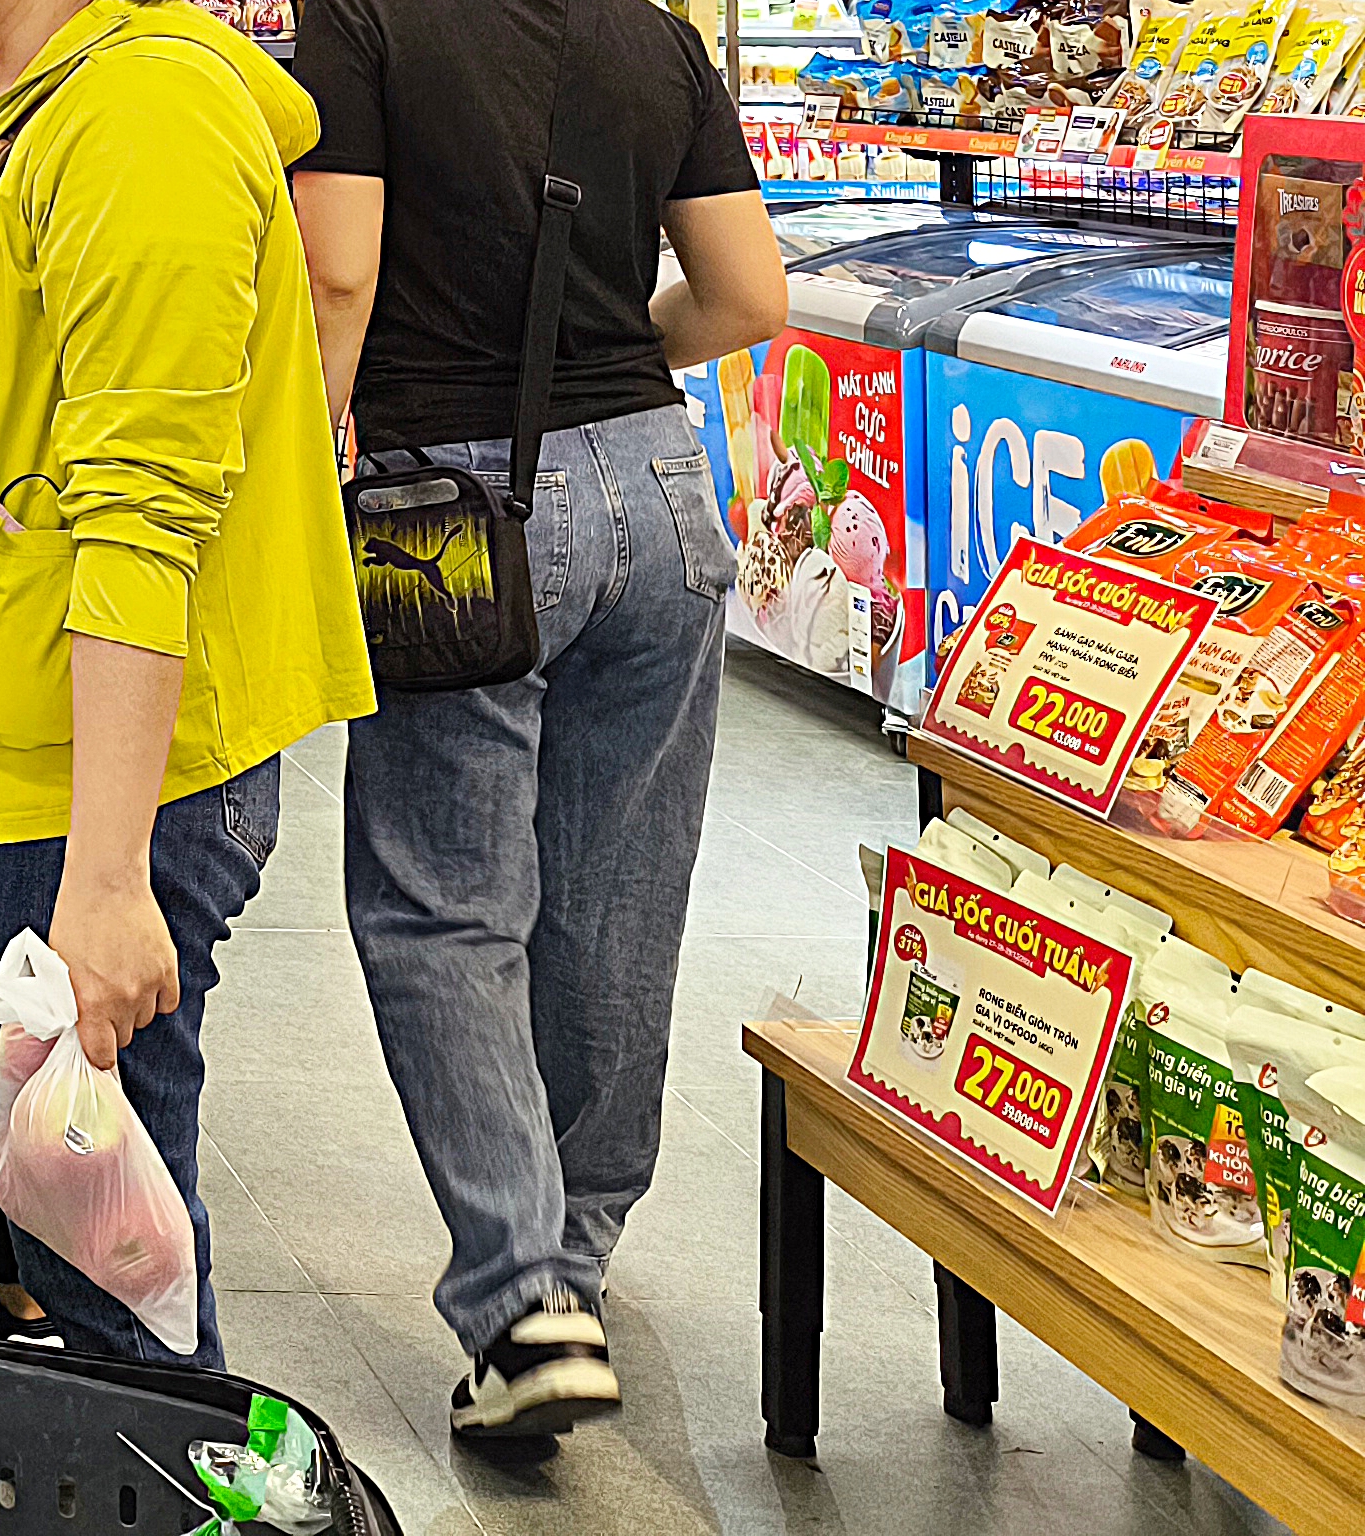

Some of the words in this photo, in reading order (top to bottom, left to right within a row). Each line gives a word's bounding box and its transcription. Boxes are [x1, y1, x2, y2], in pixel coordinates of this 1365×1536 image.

[837, 369, 862, 400] MÁT
[865, 370, 896, 402] LẠNH
[855, 402, 886, 445] CỰC
[1026, 562, 1061, 589] GIÁ
[1056, 565, 1095, 598] SỐC
[1092, 580, 1138, 612] CUỐI
[1133, 595, 1183, 629] TUẦN
[1054, 626, 1077, 642] BÁNH
[1017, 685, 1109, 739] 22.000
[897, 936, 923, 959] 31%
[914, 881, 949, 916] GIÁ
[953, 893, 992, 932] SỐC
[994, 914, 1041, 957] CUỐI
[1044, 939, 1098, 990] TUẦN
[975, 1004, 990, 1018] GIA
[993, 1012, 1002, 1028] VỊ
[978, 988, 1004, 1008] RONG
[1006, 1002, 1026, 1021] BIỂN
[1028, 1014, 1051, 1034] GIÒN
[1053, 1027, 1079, 1050] TRỘN
[963, 1045, 1061, 1119] 27.000
[1177, 1056, 1212, 1088] biển
[1164, 1074, 1186, 1096] gia
[1188, 1089, 1204, 1109] vị
[1001, 1101, 1034, 1130] 39.000
[1313, 1202, 1335, 1223] gia
[1338, 1215, 1353, 1238] vị
